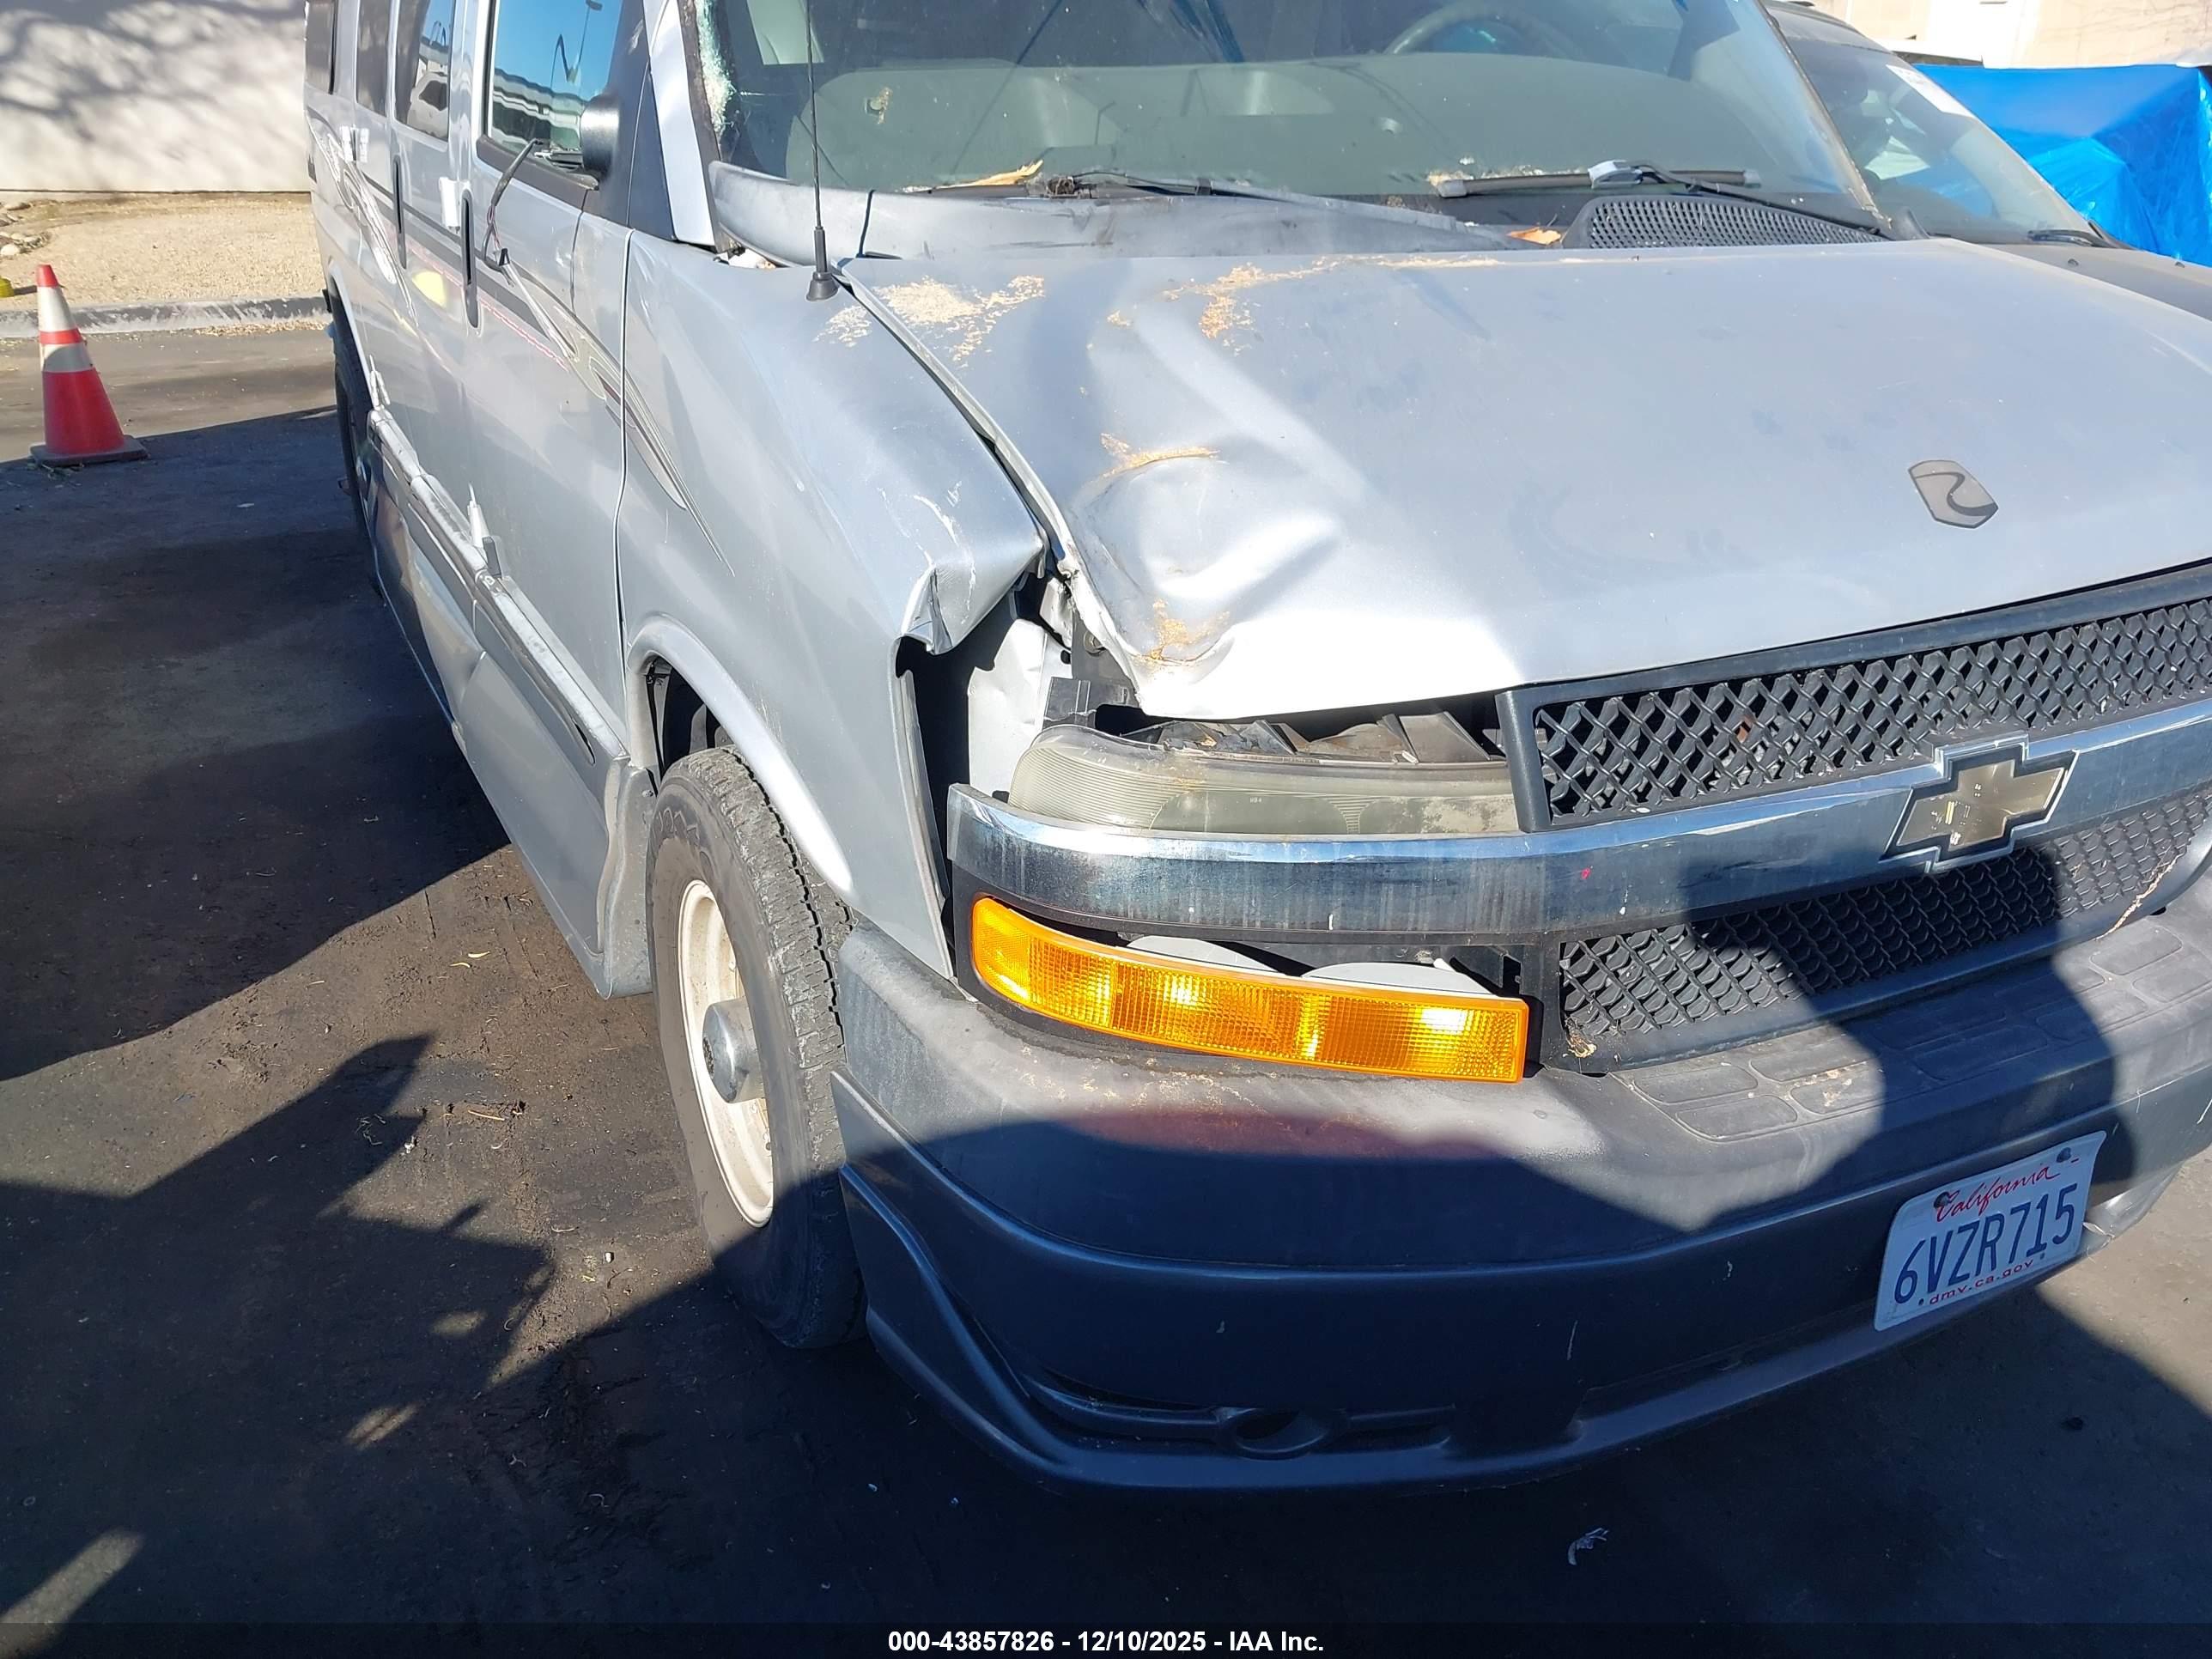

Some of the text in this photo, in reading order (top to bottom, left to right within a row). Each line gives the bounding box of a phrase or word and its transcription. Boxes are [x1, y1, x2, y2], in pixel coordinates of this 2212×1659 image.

[1936, 1164, 2061, 1222] California
[1893, 1182, 2078, 1304] 6VZR715
[1929, 1259, 2034, 1305] dmv.ca.gov
